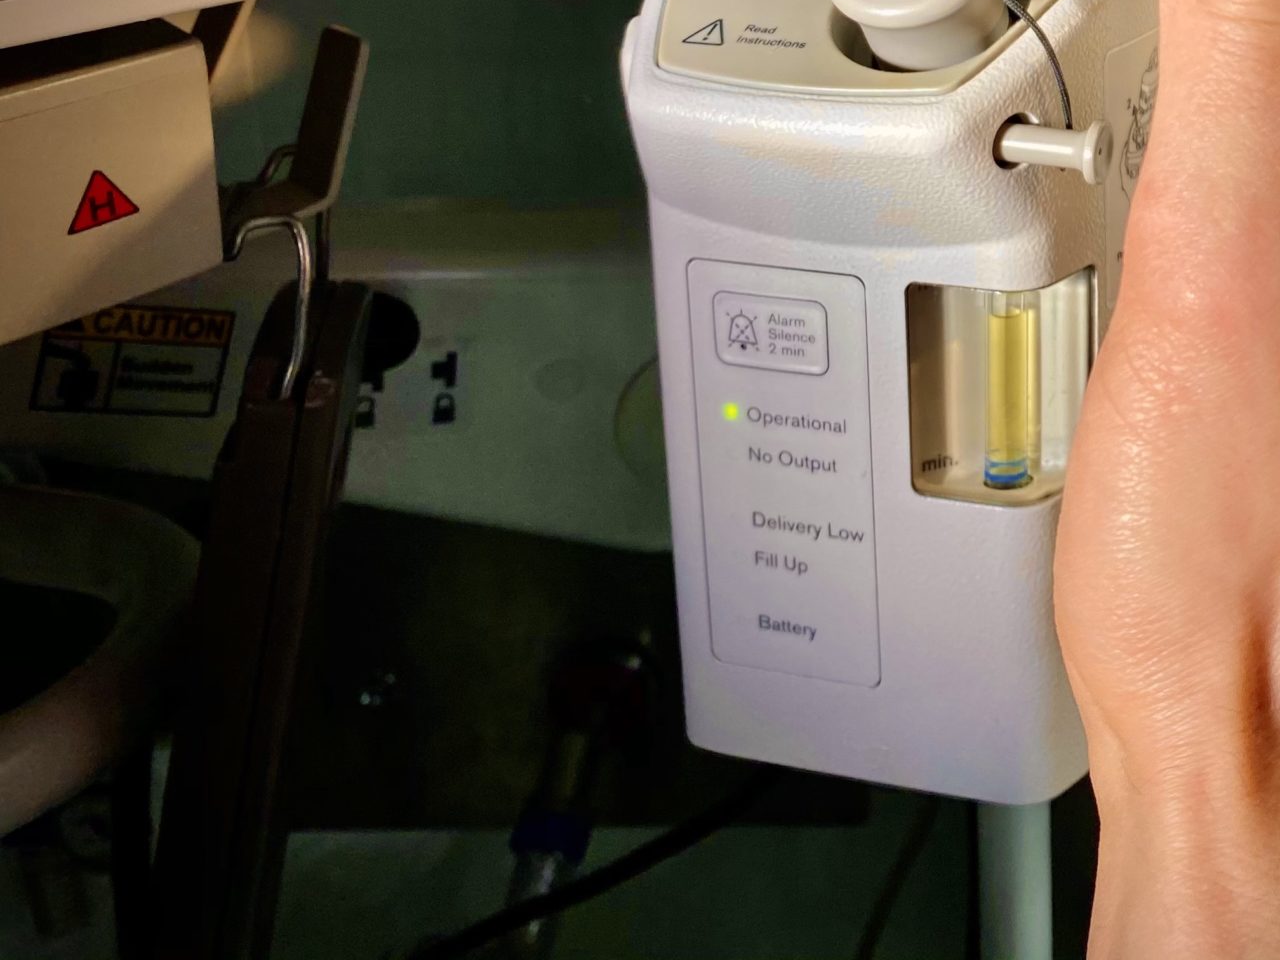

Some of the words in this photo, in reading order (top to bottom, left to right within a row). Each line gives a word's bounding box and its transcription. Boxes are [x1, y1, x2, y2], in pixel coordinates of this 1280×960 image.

[745, 24, 778, 34] Read
[93, 310, 229, 342] CAUTION
[767, 312, 806, 329] Alarm
[768, 328, 816, 345] Silence
[768, 343, 777, 356] 2
[781, 344, 806, 358] min
[746, 406, 847, 436] Operational
[748, 447, 773, 465] No
[778, 450, 838, 475] Output
[752, 511, 822, 540] Delivery
[827, 523, 865, 543] Low
[754, 551, 778, 570] Fill
[783, 556, 809, 576] Up
[758, 614, 817, 642] Battery
